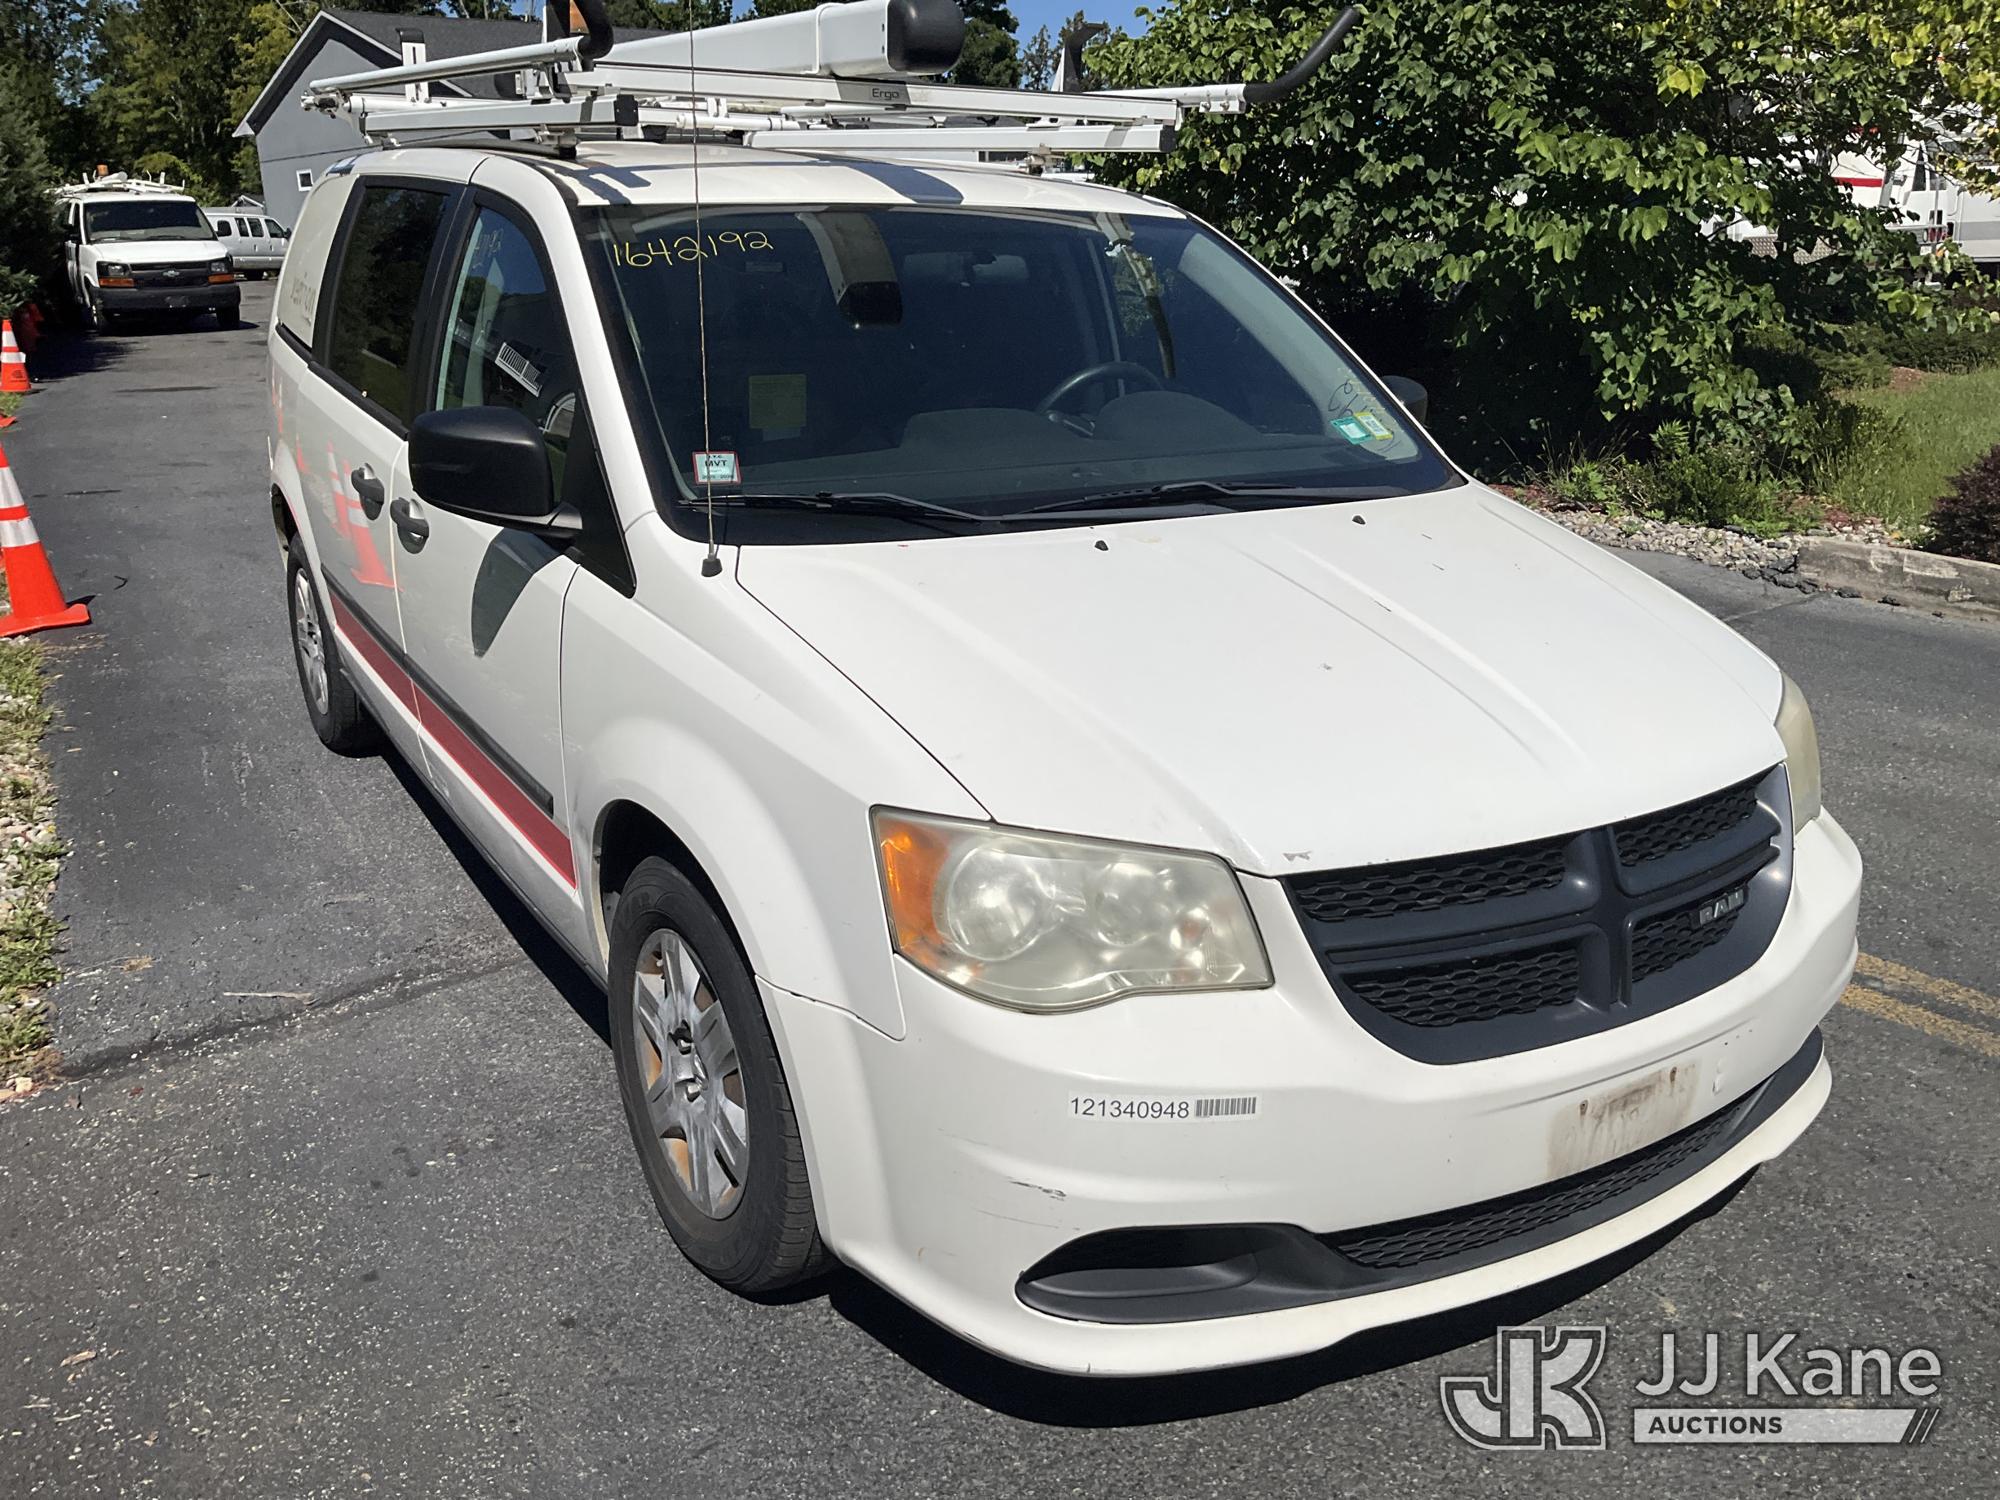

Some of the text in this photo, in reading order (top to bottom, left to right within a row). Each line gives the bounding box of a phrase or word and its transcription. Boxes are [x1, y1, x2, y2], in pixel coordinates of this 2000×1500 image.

[872, 87, 900, 101] Ergo
[613, 231, 774, 267] 1642192
[1699, 889, 1744, 926] RAM
[1070, 1097, 1190, 1119] 121340948
